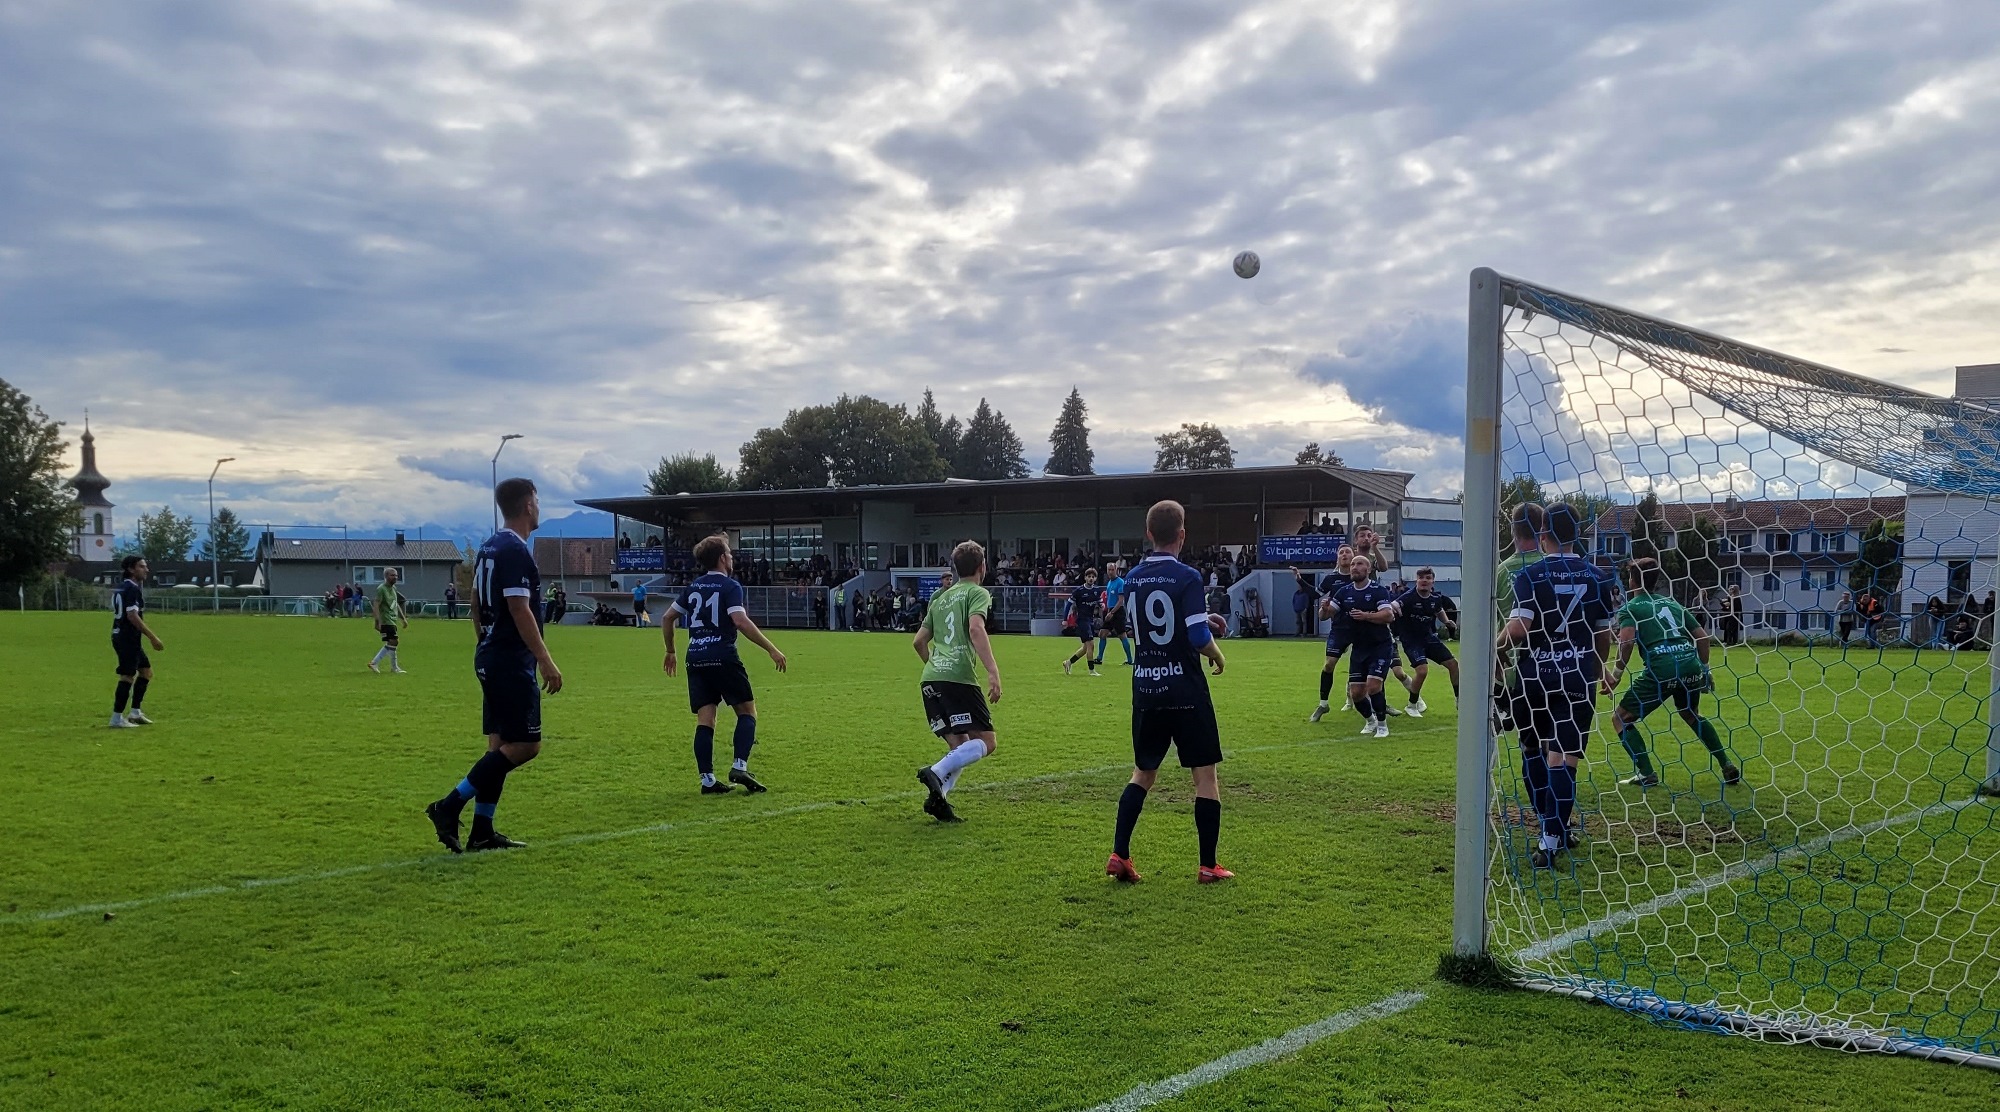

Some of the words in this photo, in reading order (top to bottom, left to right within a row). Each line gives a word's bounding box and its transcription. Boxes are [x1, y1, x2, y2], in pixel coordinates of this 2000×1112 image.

[1265, 546, 1276, 555] SV
[1276, 546, 1312, 560] typico
[687, 591, 720, 628] 21
[1126, 589, 1175, 646] 19
[1554, 583, 1588, 633] 7
[1656, 606, 1682, 637] 1
[943, 611, 955, 645] 3
